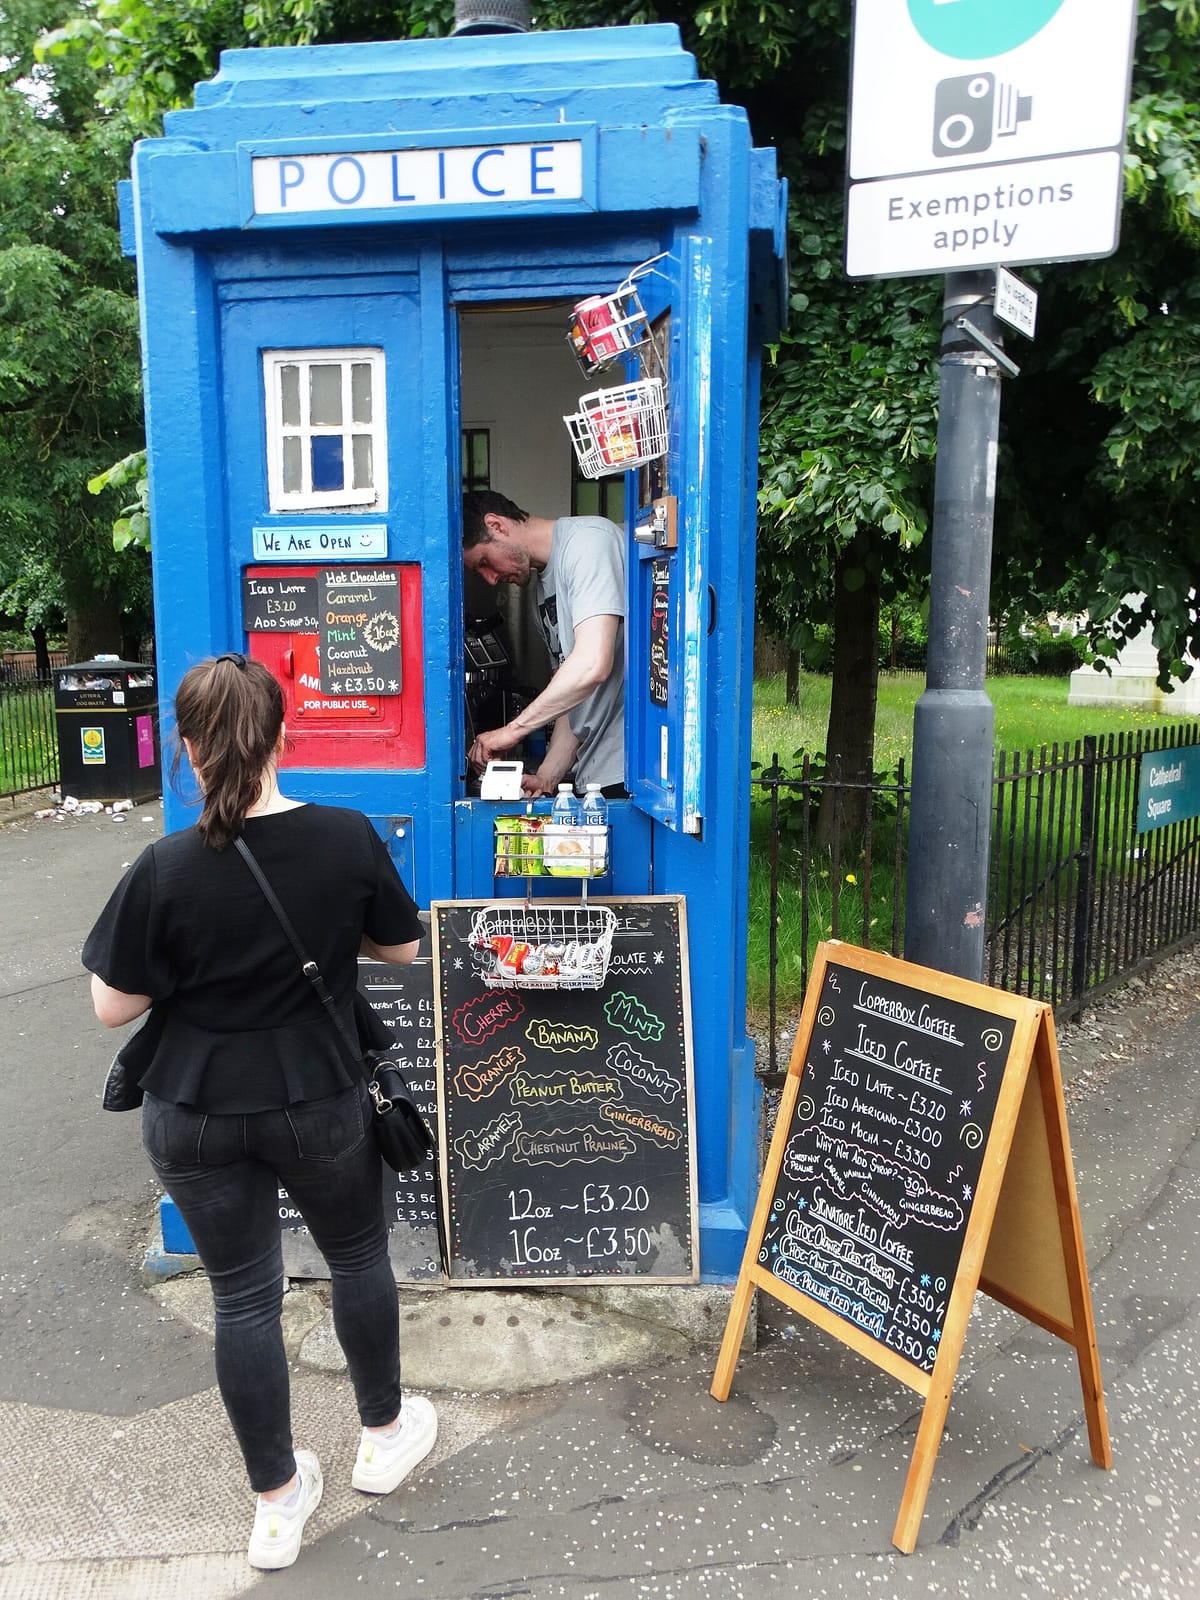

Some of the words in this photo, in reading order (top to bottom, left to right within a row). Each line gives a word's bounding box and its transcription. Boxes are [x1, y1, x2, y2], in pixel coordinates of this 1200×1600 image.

[279, 146, 556, 208] POLICE
[888, 183, 1074, 222] Exemptions
[934, 219, 1019, 252] apply
[319, 533, 352, 549] OPEN
[326, 572, 348, 584] Hot
[350, 571, 396, 584] Chocolates
[267, 600, 297, 614] £3.20
[326, 588, 377, 605] Caramel
[254, 616, 277, 629] ADD
[279, 617, 303, 629] SYRUP
[325, 612, 369, 628] Orange
[327, 627, 357, 644] Mint
[327, 645, 369, 661] Coconut
[327, 662, 374, 678] Hazelnut
[344, 677, 385, 692] £3.50
[304, 700, 321, 710] FOR
[322, 700, 350, 710] PUBLIC
[351, 700, 370, 709] USE.
[1149, 762, 1182, 788] Cathedral
[559, 816, 577, 825] ICE
[586, 815, 604, 825] ICE
[1147, 797, 1172, 821] Square
[394, 998, 412, 1011] TEA
[858, 981, 916, 1024] COPPERBOX
[918, 1003, 957, 1040] COFFEE
[395, 1015, 413, 1028] TEA
[463, 998, 514, 1037] CHERRY
[613, 999, 659, 1035] MINT
[538, 1025, 594, 1045] BANANA
[395, 1056, 414, 1069] TEA
[855, 1023, 887, 1060] ICED
[894, 1041, 942, 1085] COFFEE
[463, 1051, 517, 1093] ORANGE
[614, 1049, 673, 1094] COCONUT
[408, 1080, 424, 1092] TEA
[516, 1079, 566, 1098] PEANUT
[571, 1078, 616, 1095] BUTTER
[830, 1059, 859, 1087] ICED
[865, 1073, 895, 1100] LATTE
[909, 1091, 946, 1121] £3.20
[604, 1107, 676, 1142] GINGERBREAD
[820, 1107, 845, 1131] ICED
[851, 1121, 879, 1146] MOCHA
[823, 1085, 848, 1109] ICED
[904, 1117, 942, 1148] £3.00
[463, 1116, 520, 1161] CARAMEL
[520, 1135, 580, 1156] CHESTNUT
[583, 1133, 628, 1153] PRALINE
[789, 1150, 821, 1163] CHESTNUT
[790, 1160, 814, 1174] PRALINE
[816, 1134, 832, 1153] WHY
[851, 1150, 868, 1168] ADD
[904, 1176, 925, 1198] 30p
[824, 1157, 846, 1194] CARAMEL
[843, 1169, 873, 1180] VANILLA
[583, 1184, 650, 1215] £3.20
[861, 1182, 900, 1222] CINNAMON
[899, 1198, 955, 1219] GINGERBREAD
[810, 1186, 855, 1232] SIGNATURE
[854, 1208, 877, 1244] ICED
[879, 1221, 914, 1266] COFFEE
[586, 1227, 651, 1258] £3.50
[842, 1242, 861, 1265] ICED
[830, 1263, 853, 1287] ICED
[857, 1279, 887, 1310] MOCHA
[893, 1303, 931, 1337] £3.50
[829, 1288, 850, 1313] ICED
[851, 1305, 881, 1335] MOCHA
[886, 1325, 922, 1359] £3.50
